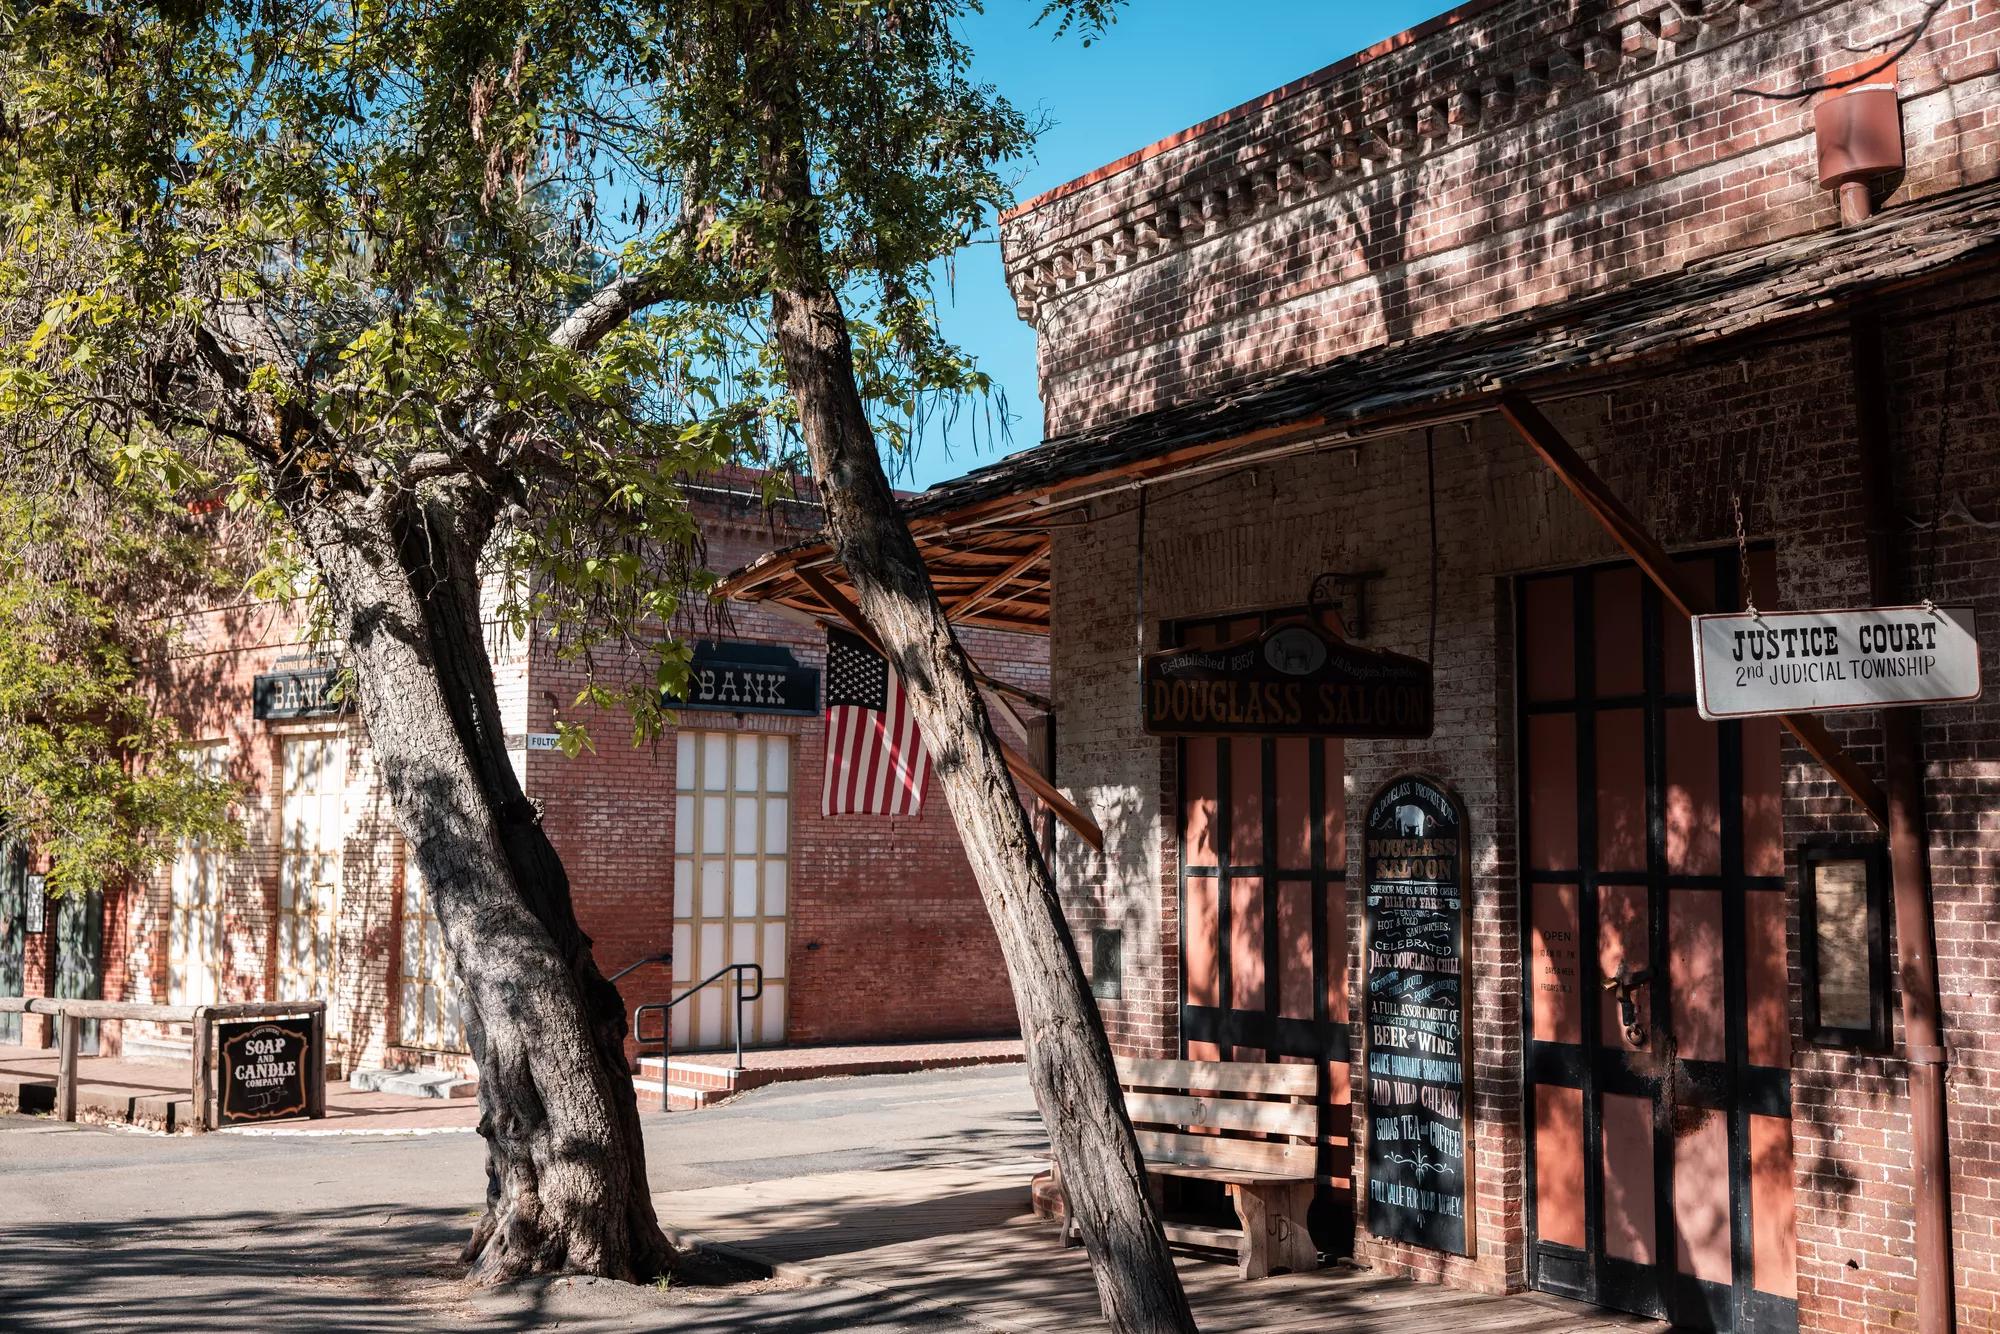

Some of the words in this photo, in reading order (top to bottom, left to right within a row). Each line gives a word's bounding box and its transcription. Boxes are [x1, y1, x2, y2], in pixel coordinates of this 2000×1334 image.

[1732, 626, 1838, 662] JUSTICE
[1859, 622, 1937, 654] COURT
[1160, 653, 1225, 675] Established
[1231, 649, 1256, 672] 1857
[1735, 661, 1764, 687] 2nd
[1769, 660, 1846, 686] JUDICIAL
[1849, 655, 1936, 680] TOWNSHIP
[273, 676, 327, 710] BANK
[699, 670, 786, 704] BANK
[1152, 679, 1303, 724] DOUGLASS
[1318, 681, 1425, 727] SALOON
[532, 737, 559, 746] FULTO
[1380, 782, 1411, 812] DOUGLASS
[1368, 838, 1456, 857] DOUGLASS
[1376, 859, 1452, 880] SALOON
[1370, 885, 1395, 895] SUPERIOR
[1396, 886, 1413, 895] MEALS
[1430, 886, 1438, 896] TO
[1384, 896, 1404, 908] BILL
[1406, 897, 1417, 909] OF
[1394, 909, 1430, 918] FEATURING
[1377, 920, 1394, 931] HOT
[1402, 917, 1419, 926] COLD
[1375, 938, 1452, 956] CELEBRATED
[1544, 931, 1571, 941] OPEN
[1369, 948, 1392, 974] JACK
[1394, 952, 1435, 972] DOUGLASS
[1403, 974, 1423, 991] LIQUID
[1371, 1001, 1378, 1014] A
[1379, 1002, 1399, 1016] FULL
[1400, 1004, 1448, 1021] ASSORTMENT
[1449, 1010, 1460, 1023] OF
[1373, 1014, 1408, 1026] IMPORTED
[1420, 1020, 1457, 1040] DOMESTIC
[1373, 1025, 1409, 1049] BEER
[245, 1038, 286, 1056] SOAP
[257, 1055, 275, 1063] AND
[1370, 1052, 1391, 1075] CHOICE
[234, 1061, 296, 1080] CANDLE
[245, 1078, 286, 1088] COMPANY
[1371, 1078, 1391, 1106] AND
[1393, 1080, 1418, 1105] WILD
[1376, 1117, 1399, 1141] SODAS
[1401, 1115, 1421, 1141] TEA
[1371, 1179, 1386, 1204] FULL
[1387, 1180, 1405, 1207] VALUE
[1406, 1186, 1419, 1210] FOR
[1420, 1189, 1436, 1213] YOUR
[1268, 1214, 1290, 1242] JD
